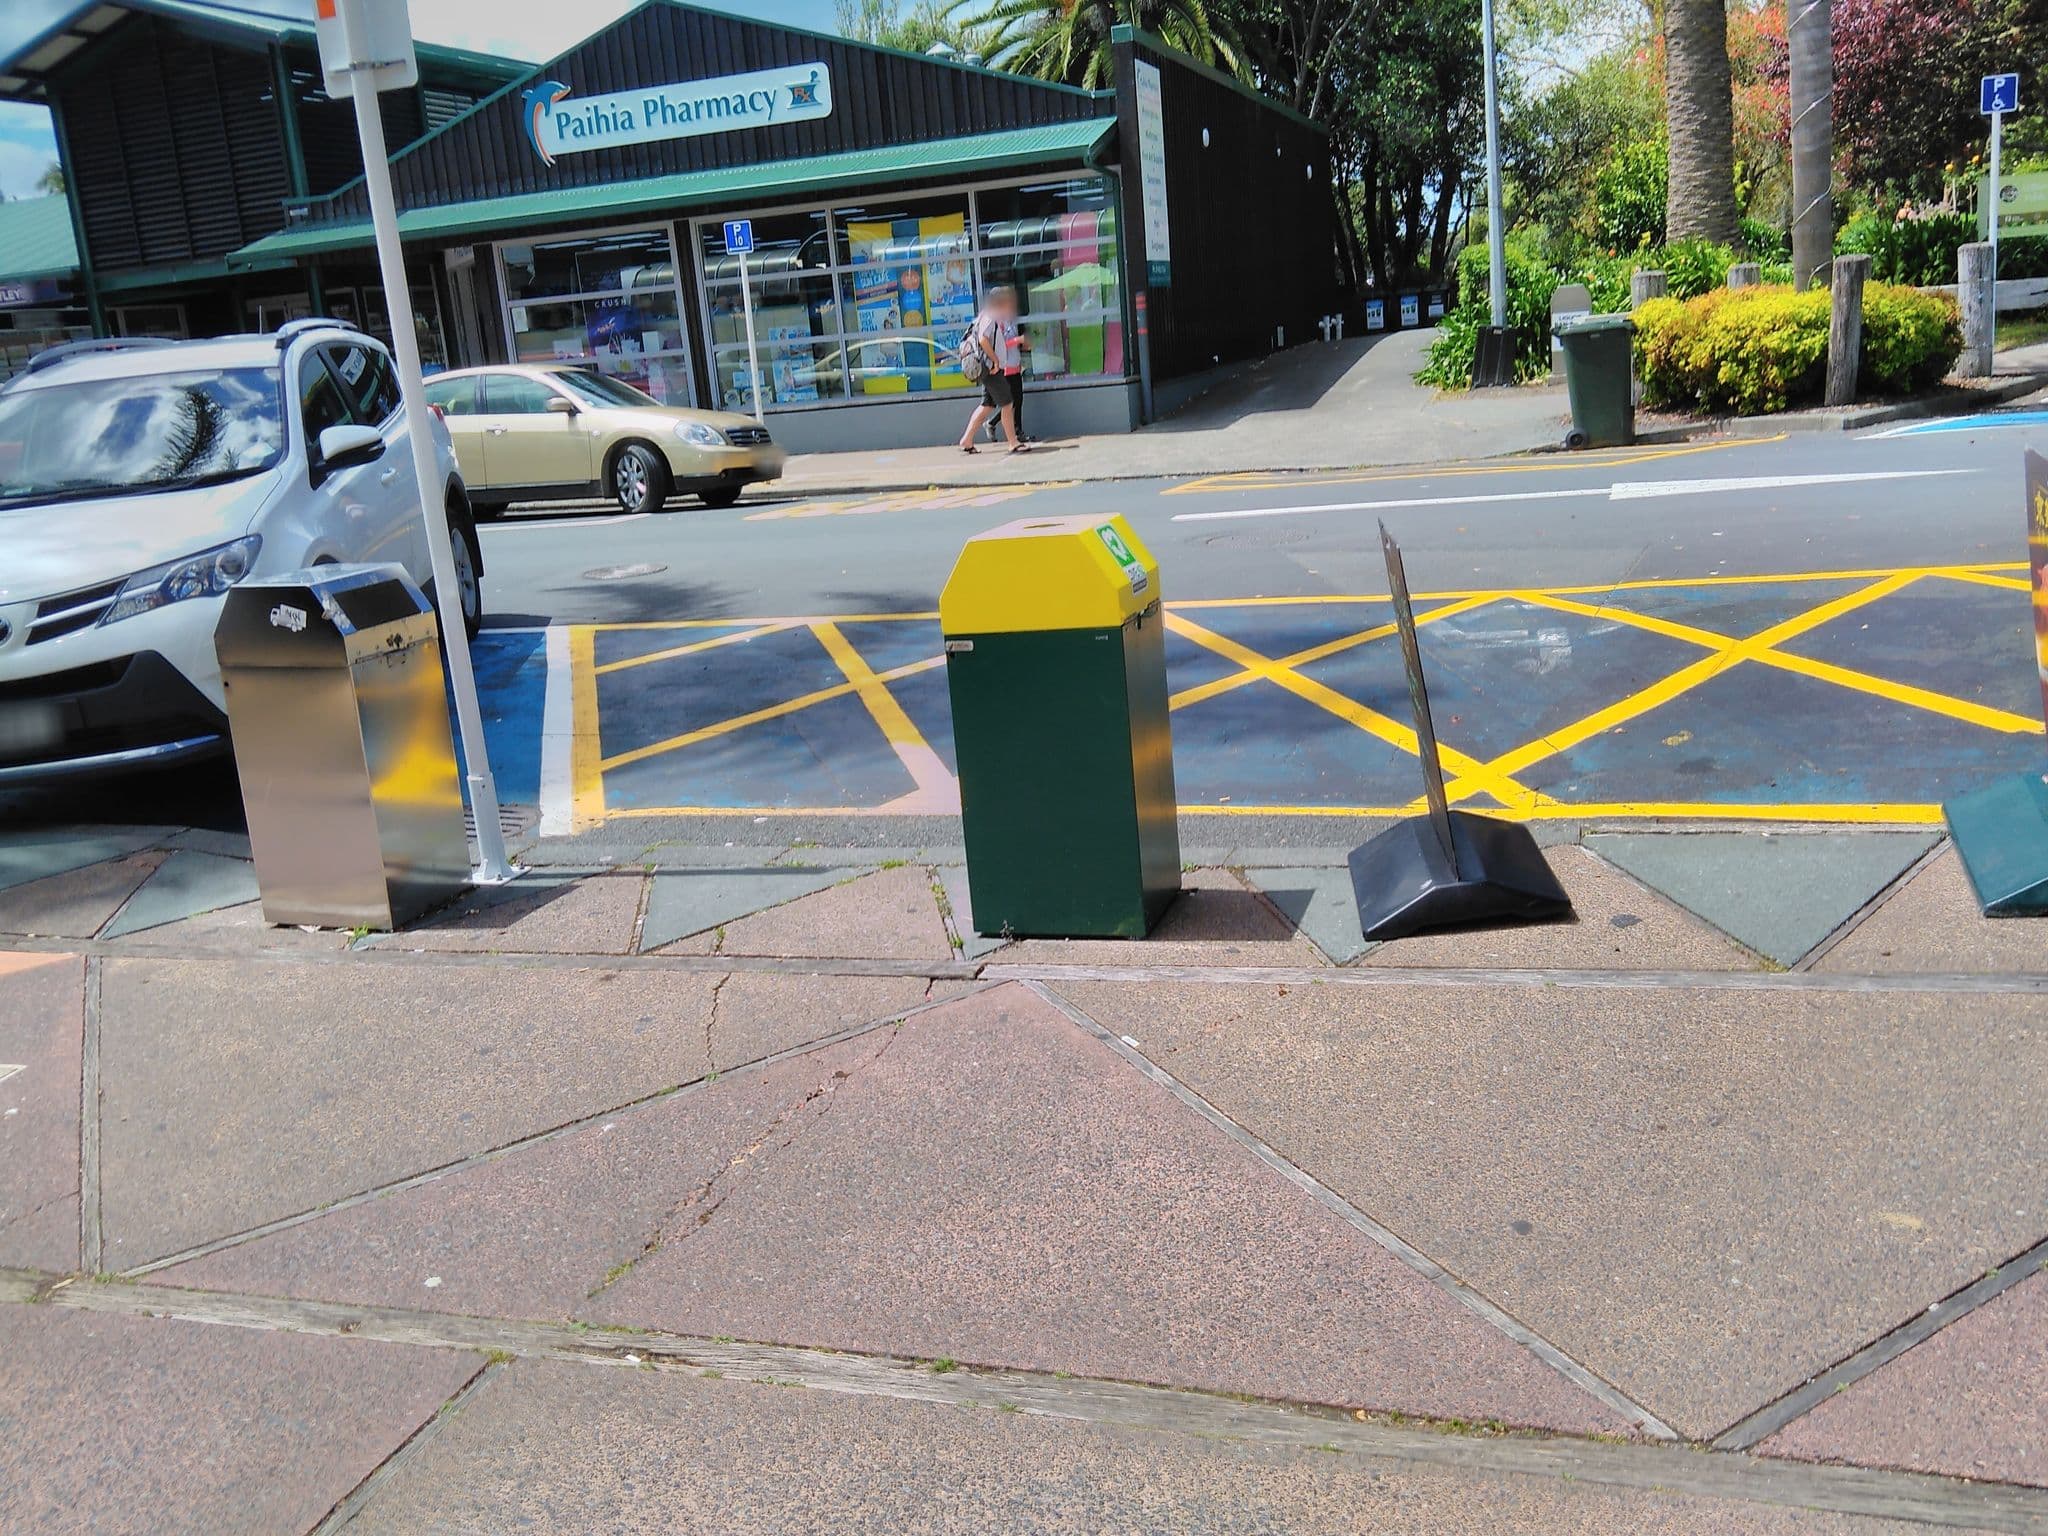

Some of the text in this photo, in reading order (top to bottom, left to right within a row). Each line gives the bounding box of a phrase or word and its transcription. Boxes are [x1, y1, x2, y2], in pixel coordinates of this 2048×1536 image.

[1993, 78, 2006, 93] P
[555, 88, 777, 139] Paihia Pharmacy
[733, 223, 742, 237] P
[735, 235, 744, 246] 10
